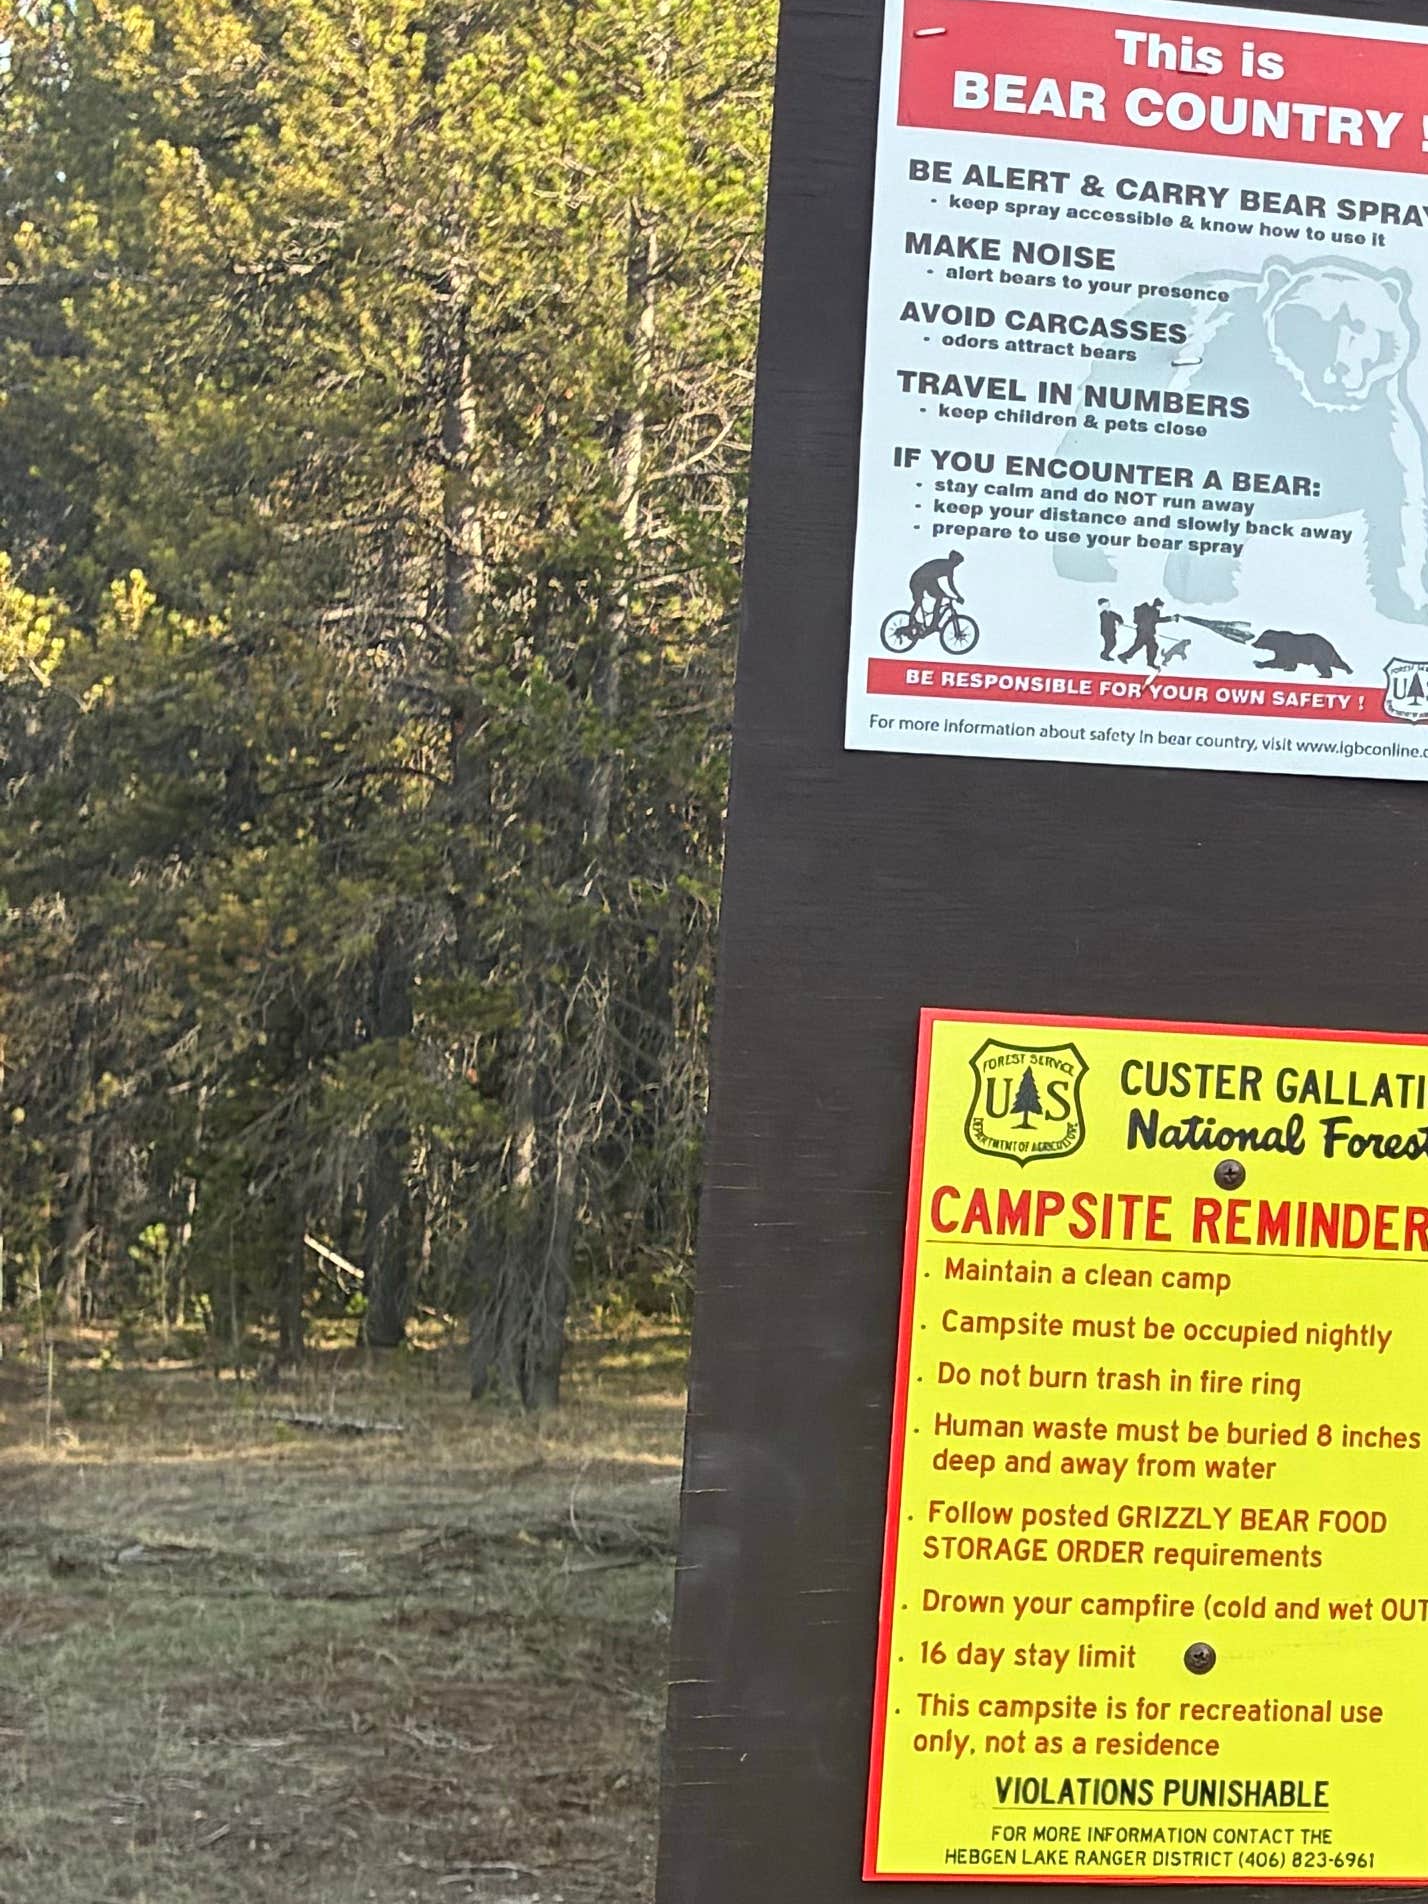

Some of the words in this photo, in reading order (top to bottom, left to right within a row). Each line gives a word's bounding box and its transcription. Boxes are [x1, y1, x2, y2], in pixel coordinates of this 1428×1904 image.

[1115, 29, 1223, 74] This
[1242, 42, 1284, 80] is
[953, 70, 1105, 122] BEAR
[1125, 87, 1403, 149] COUNTRY
[909, 158, 952, 184] BE
[962, 164, 1071, 194] ALERT
[1080, 174, 1105, 198] &
[1116, 178, 1230, 209] CARRY
[1240, 189, 1326, 218] BEAR
[894, 446, 922, 468] IF
[931, 449, 995, 474] YOU
[1006, 455, 1193, 488] ENCOUNTER
[1202, 470, 1223, 490] A
[1232, 471, 1321, 497] BEAR:
[906, 669, 934, 685] BE
[941, 671, 1092, 695] RESPONSIBLE
[1100, 681, 1141, 698] FOR
[1149, 685, 1208, 702] YOUR
[1215, 688, 1265, 705] OWN
[1272, 691, 1351, 709] SAFETY
[1359, 695, 1364, 710] !
[869, 713, 895, 729] For
[899, 719, 940, 732] more
[944, 718, 1035, 737] information
[1039, 724, 1086, 740] about
[1090, 727, 1136, 746] safety
[1139, 729, 1153, 744] in
[1158, 730, 1192, 746] bear
[1195, 736, 1258, 753] country,
[1262, 737, 1292, 751] visit
[1121, 1059, 1262, 1101] CUSTER
[1127, 1108, 1305, 1155] National
[931, 1185, 1172, 1242] CAMPSITE
[945, 1257, 1052, 1284] Maintain
[1062, 1267, 1076, 1285] a
[1085, 1263, 1152, 1288] clean
[1161, 1271, 1231, 1297] camp
[923, 1589, 1004, 1613] Drown
[1013, 1596, 1073, 1621] your
[1081, 1593, 1195, 1623] campfire
[1204, 1594, 1266, 1620] (cold
[1275, 1597, 1320, 1620] and
[1328, 1598, 1373, 1620] wet
[996, 1776, 1154, 1806] VIOLATIONS
[1163, 1779, 1329, 1807] PUNISHABLE
[991, 1825, 1027, 1842] FOR
[1033, 1826, 1081, 1842] MORE
[1088, 1826, 1207, 1844] INFORMATION
[1213, 1828, 1295, 1844] CONTACT
[1300, 1828, 1332, 1845] THE
[945, 1848, 1016, 1865] HEBGEN
[1022, 1849, 1069, 1865] LAKE
[1075, 1850, 1146, 1866] RANGER
[1153, 1851, 1233, 1867] DISTRICT
[1239, 1851, 1286, 1869] (406)
[1292, 1851, 1374, 1868] 823-6961
